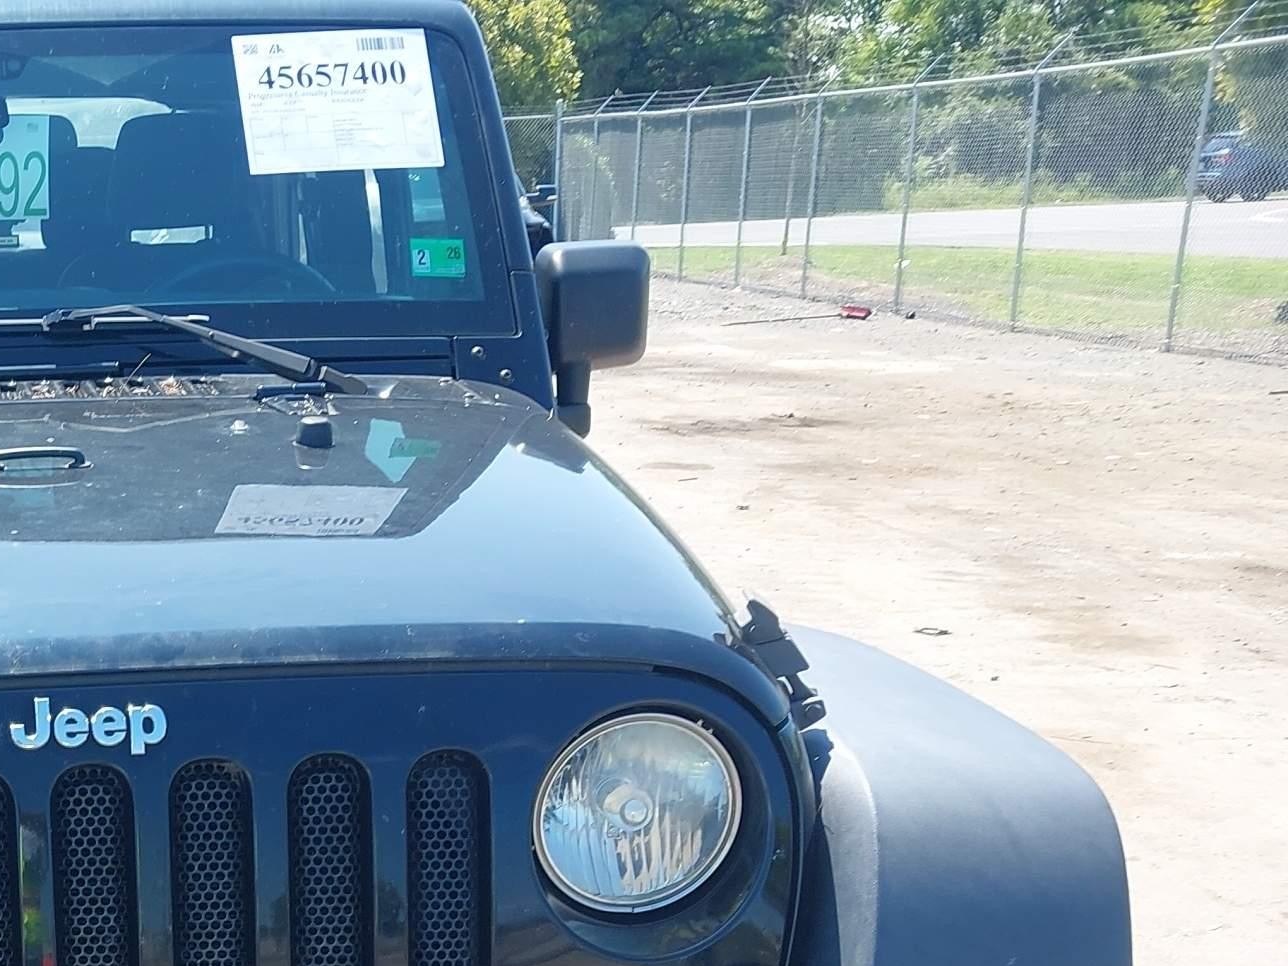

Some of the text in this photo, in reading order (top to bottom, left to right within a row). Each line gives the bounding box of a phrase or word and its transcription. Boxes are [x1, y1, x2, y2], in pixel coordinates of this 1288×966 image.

[258, 60, 406, 90] 45657400
[417, 249, 426, 264] 2
[9, 696, 167, 755] Jeep
